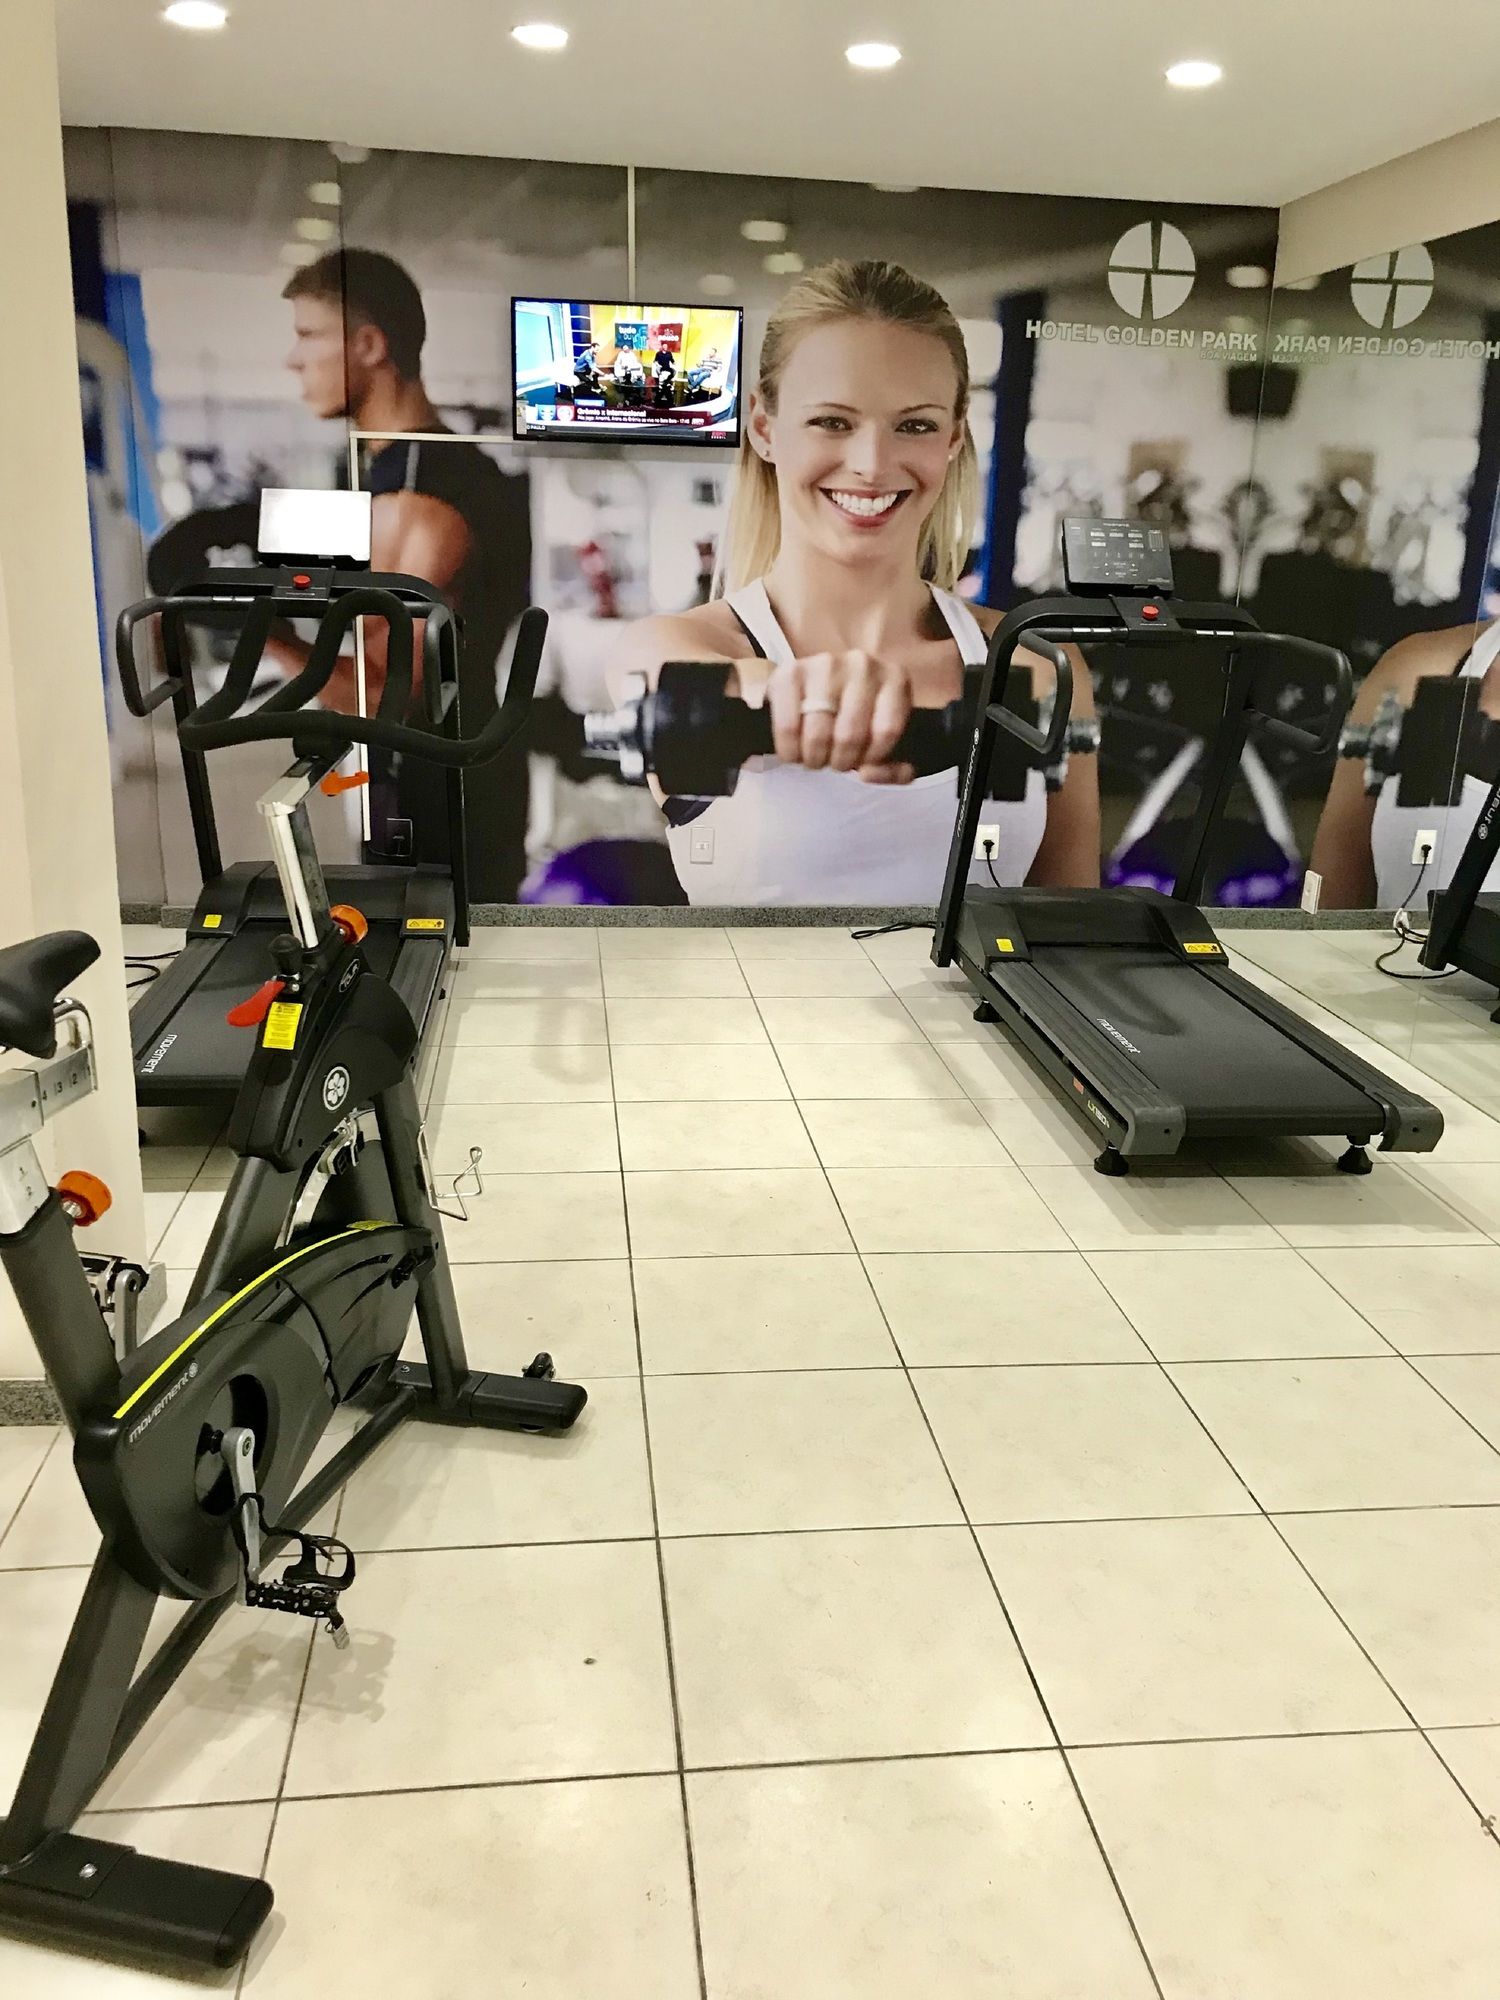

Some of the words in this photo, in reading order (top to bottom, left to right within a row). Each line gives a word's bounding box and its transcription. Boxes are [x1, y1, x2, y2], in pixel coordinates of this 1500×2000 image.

[1025, 319, 1098, 343] HOTEL
[1104, 325, 1195, 348] GOLDEN
[1201, 330, 1258, 351] PARK
[1200, 351, 1220, 360] BOA
[1222, 352, 1258, 362] VIAGEM
[141, 1034, 178, 1073] movement
[129, 1372, 189, 1443] movement
